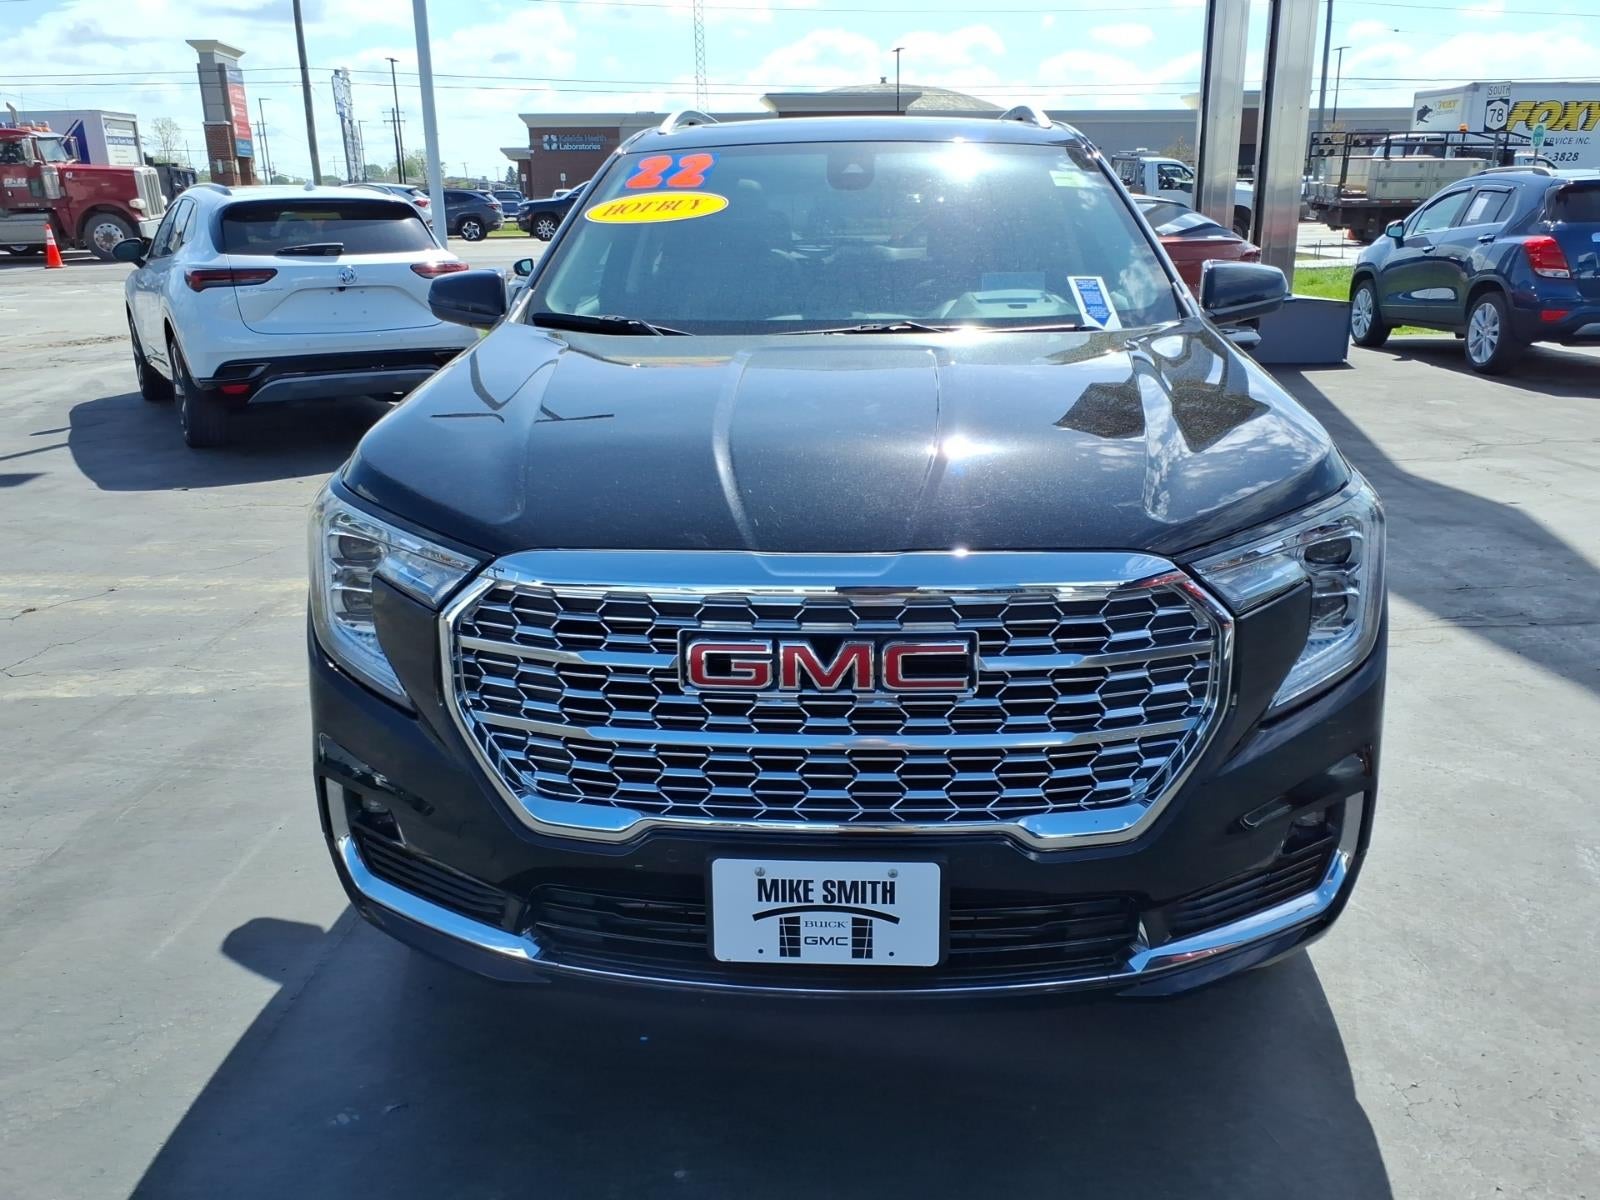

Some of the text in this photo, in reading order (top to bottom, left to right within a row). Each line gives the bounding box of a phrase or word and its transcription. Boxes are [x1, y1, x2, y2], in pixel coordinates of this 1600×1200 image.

[1488, 84, 1511, 96] SOUTH
[1489, 108, 1504, 123] 78
[1544, 137, 1591, 145] ERVICE INC.
[626, 153, 713, 188] 22
[602, 198, 710, 217] HOT BUY
[687, 639, 969, 690] GMC
[757, 878, 896, 905] MIKE SMITH
[803, 920, 846, 929] BUICK
[804, 936, 849, 946] GMC
